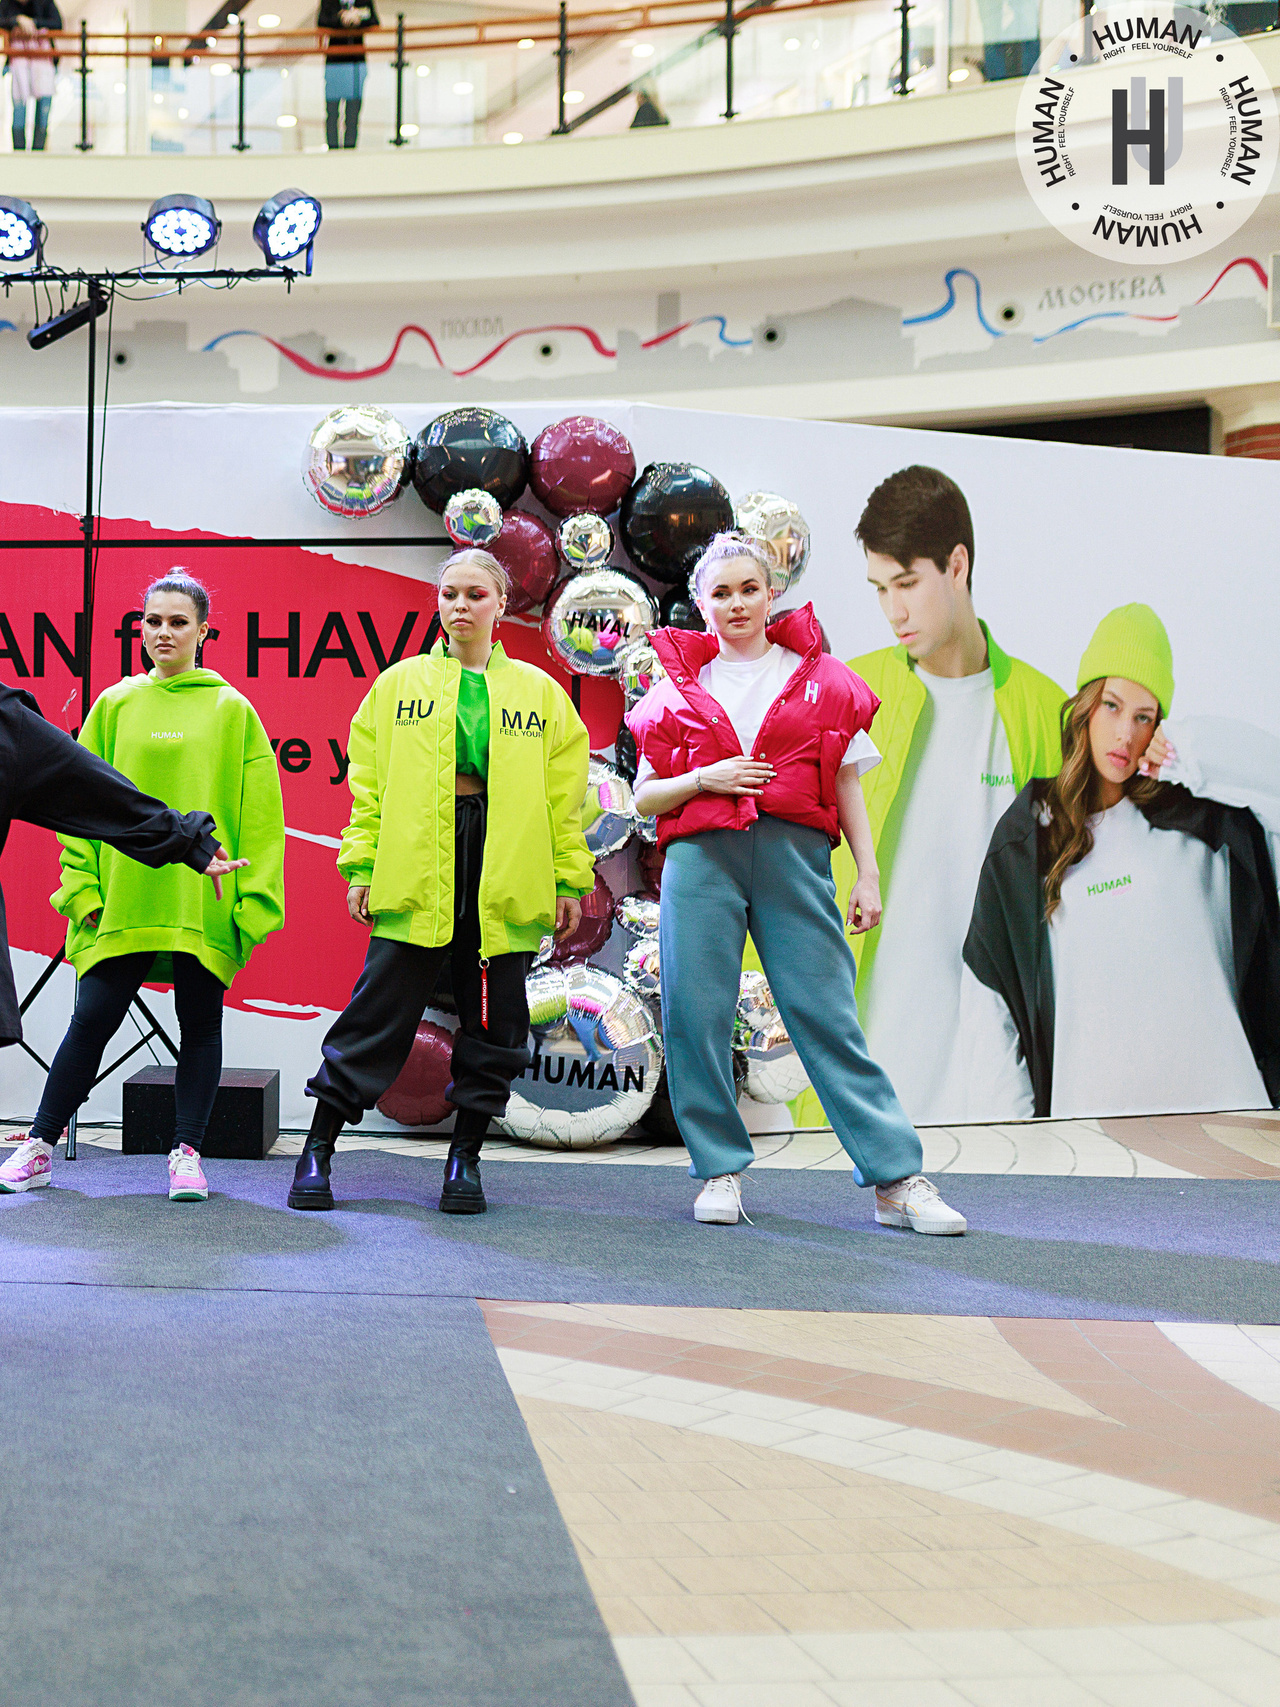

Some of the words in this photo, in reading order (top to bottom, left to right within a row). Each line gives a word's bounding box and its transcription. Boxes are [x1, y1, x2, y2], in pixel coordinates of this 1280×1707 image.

[569, 611, 630, 638] HAVAL
[396, 699, 435, 719] HU
[151, 731, 184, 739] HUMAN
[499, 728, 519, 737] FEEL
[1087, 874, 1132, 896] HUMAN
[520, 1053, 645, 1093] HUMAN
